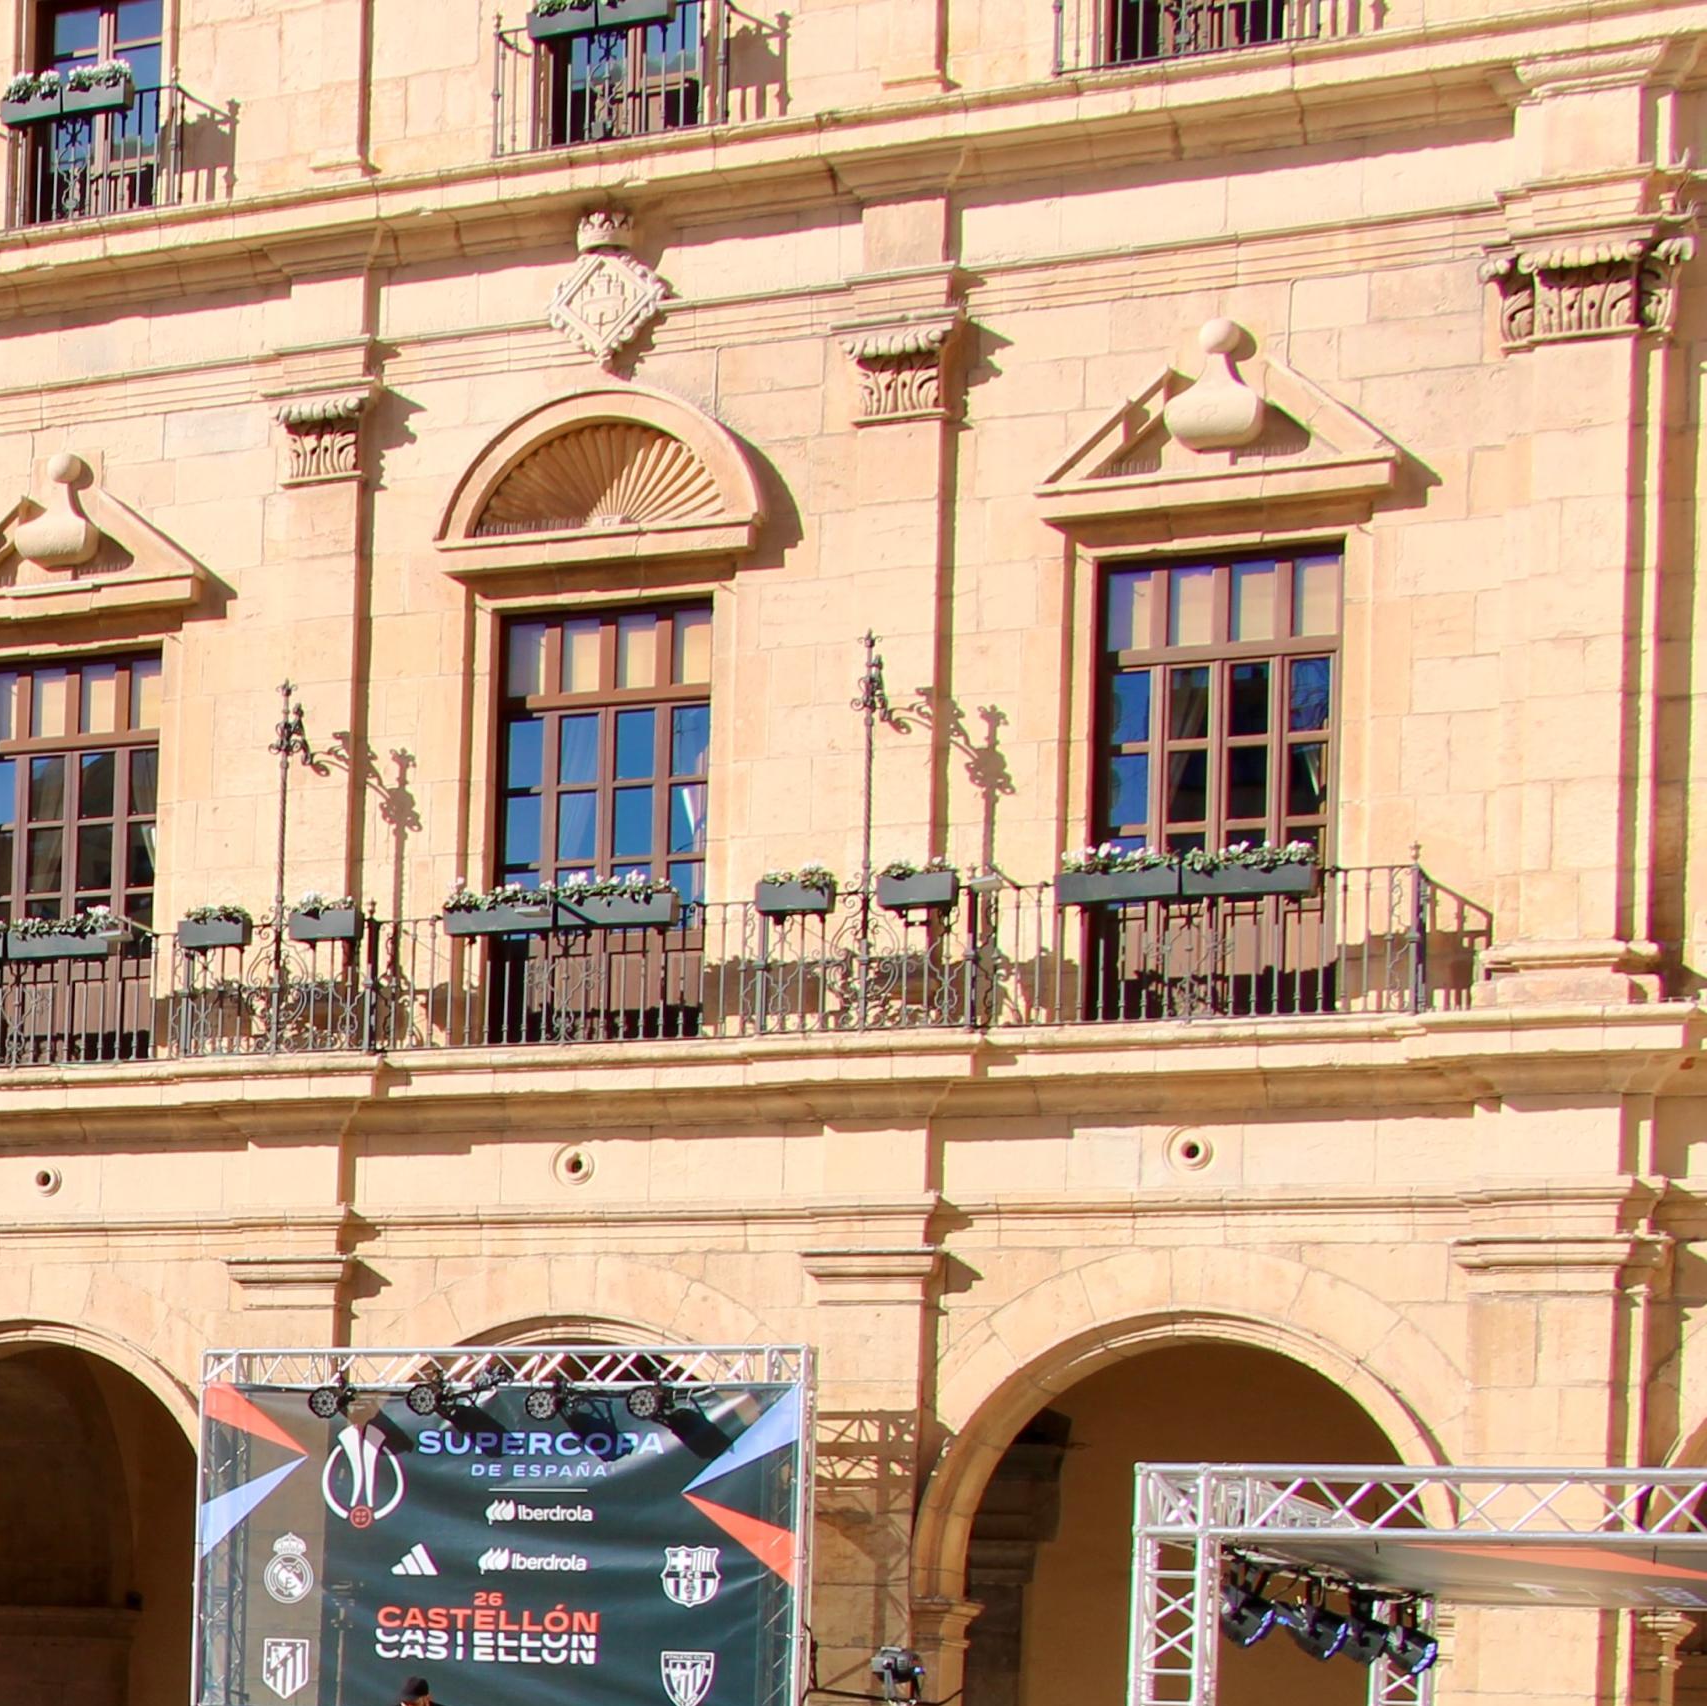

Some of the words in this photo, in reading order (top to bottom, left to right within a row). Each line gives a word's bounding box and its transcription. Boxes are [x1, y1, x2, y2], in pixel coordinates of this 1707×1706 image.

[418, 1430, 664, 1456] SUPERCOPA
[470, 1463, 502, 1477] DE
[512, 1462, 607, 1477] ESPAÑA
[517, 1504, 593, 1522] Iberdrola
[511, 1552, 587, 1571] Iberdrola
[473, 1592, 503, 1607] 26
[377, 1604, 599, 1633] CASTELLÓN
